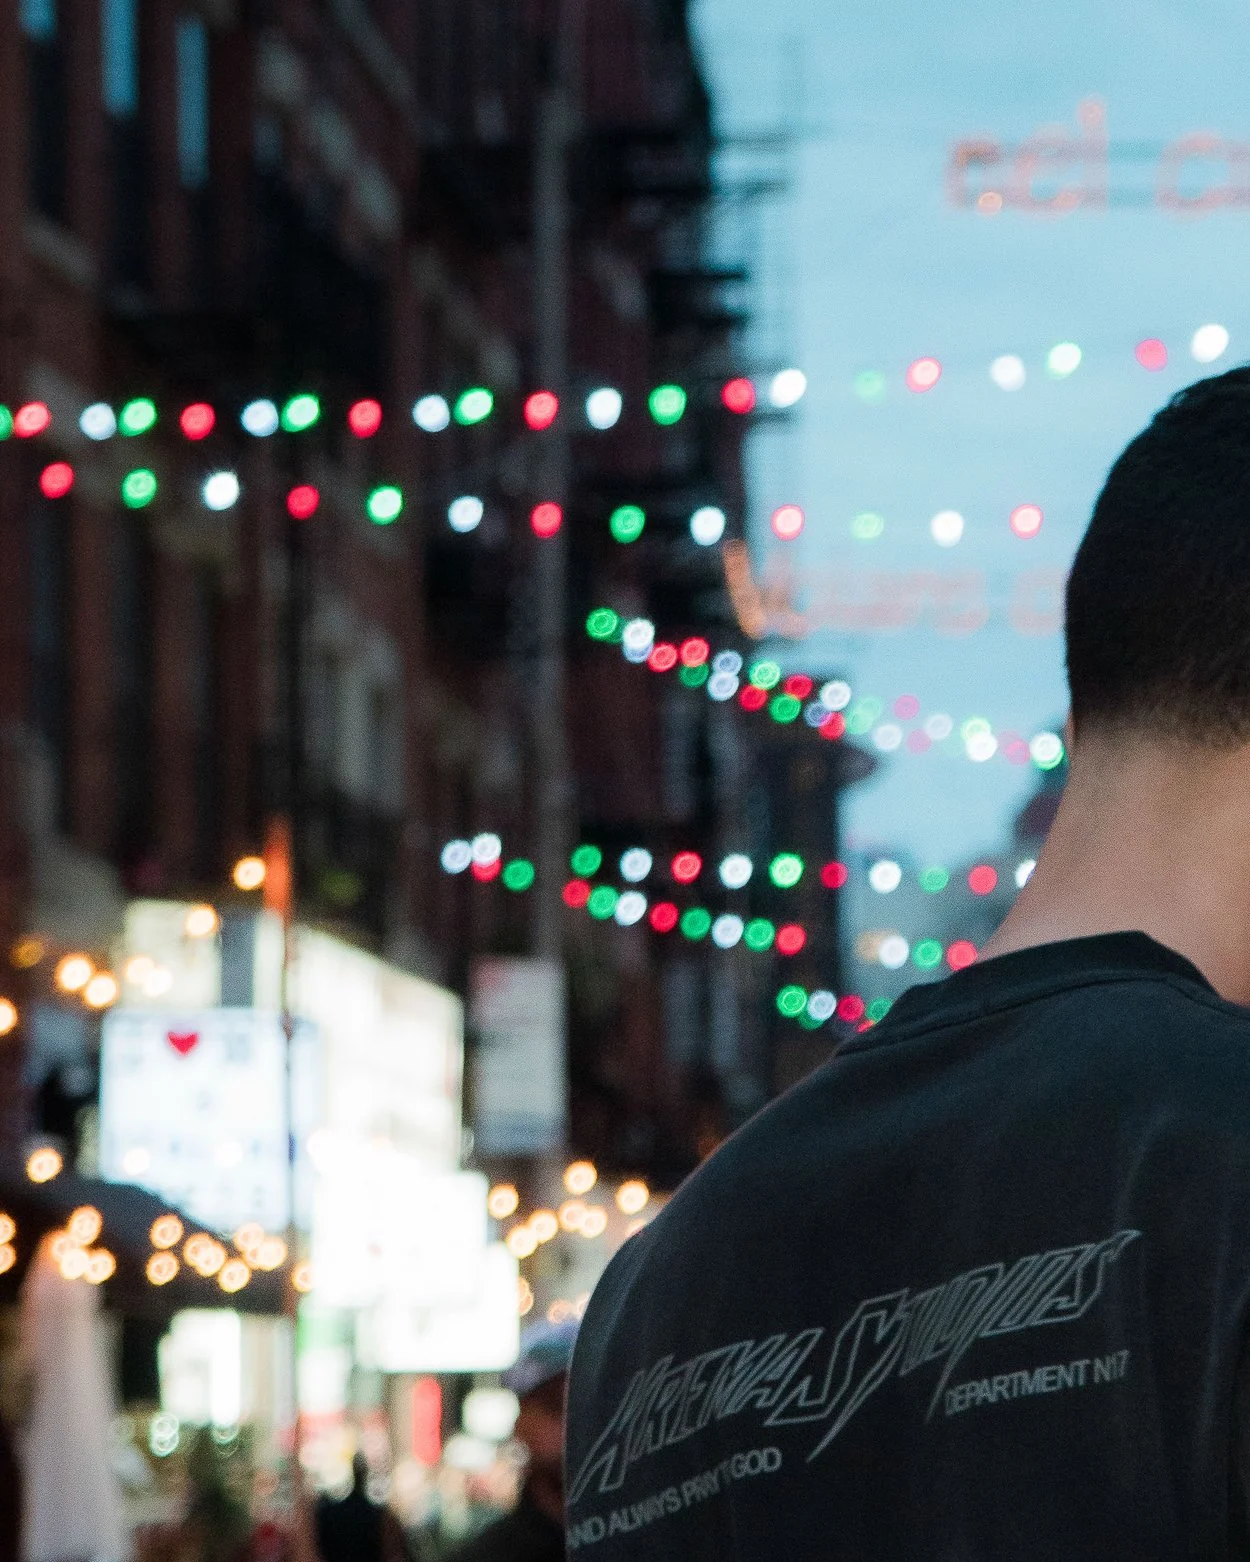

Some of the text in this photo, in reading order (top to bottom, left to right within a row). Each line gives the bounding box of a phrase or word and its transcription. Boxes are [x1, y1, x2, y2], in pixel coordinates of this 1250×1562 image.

[945, 1359, 1090, 1417] DEPARTMENT
[608, 1486, 682, 1536] ALWAYS
[730, 1446, 783, 1480] GOD
